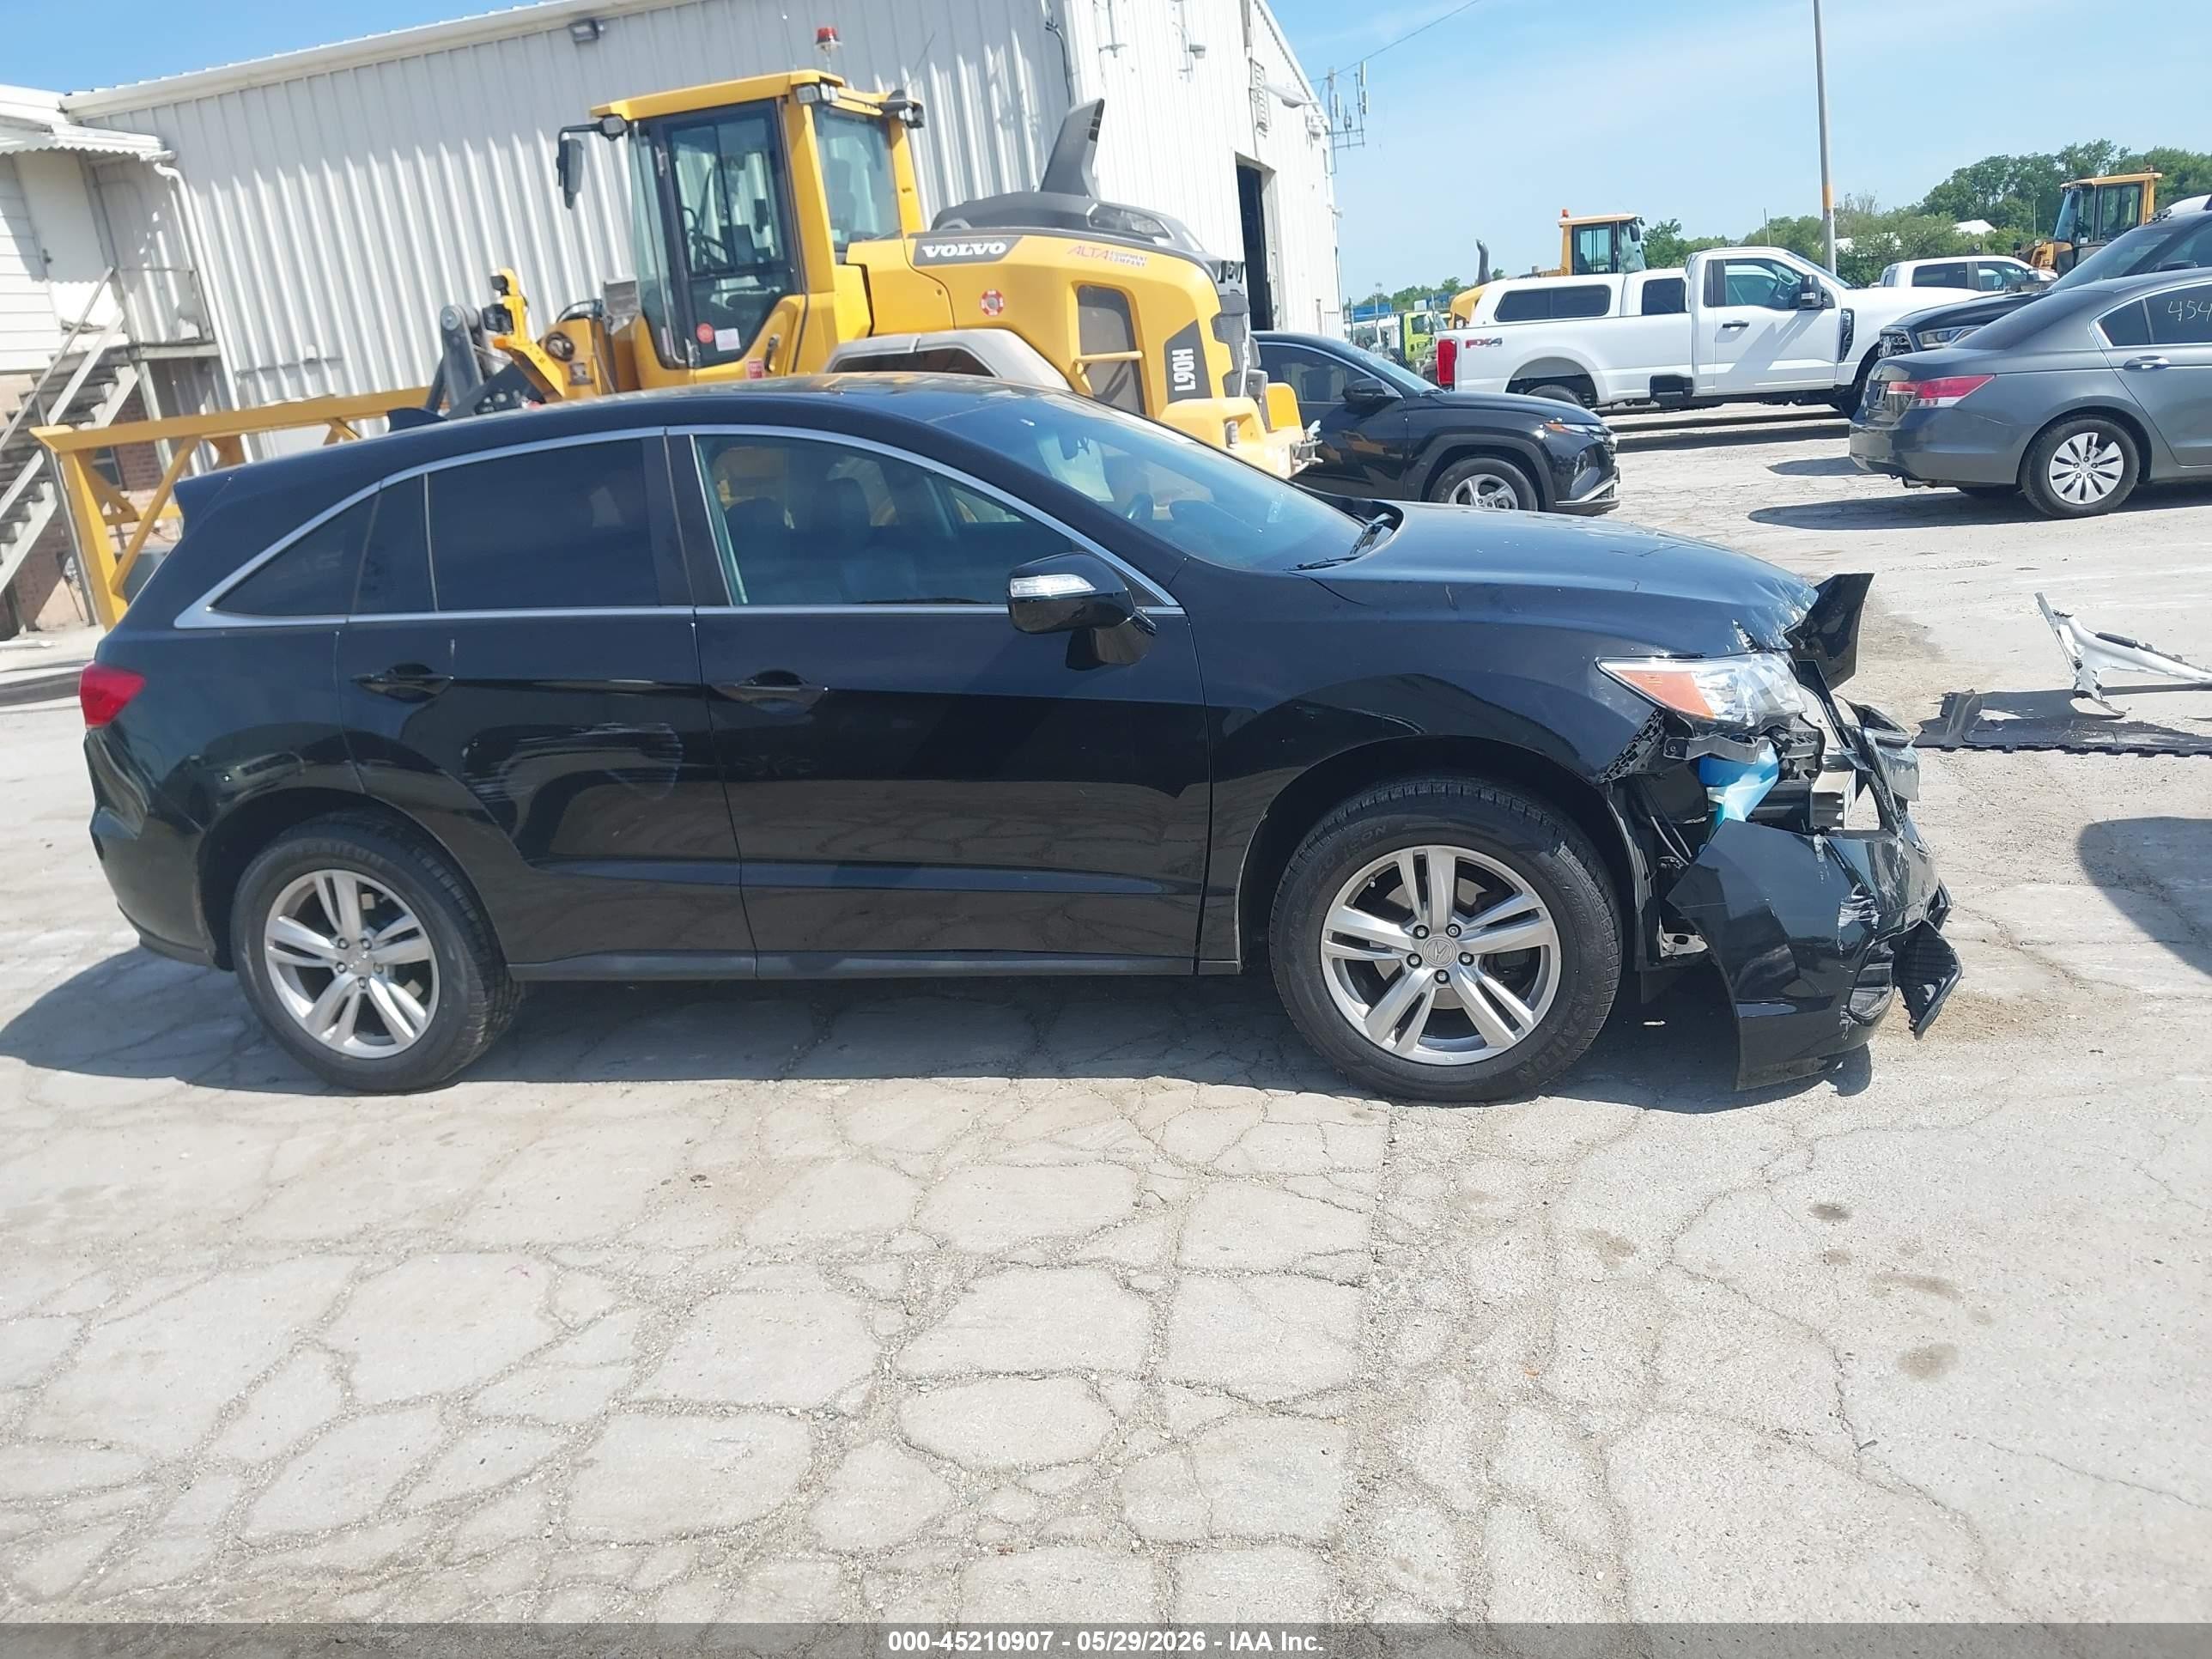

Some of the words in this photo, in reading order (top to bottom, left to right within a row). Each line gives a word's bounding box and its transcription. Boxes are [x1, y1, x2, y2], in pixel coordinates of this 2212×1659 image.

[922, 241, 1007, 258] VOLVO
[1067, 246, 1109, 260] ALTA
[1466, 337, 1503, 349] FX4
[1171, 348, 1196, 392] L90H
